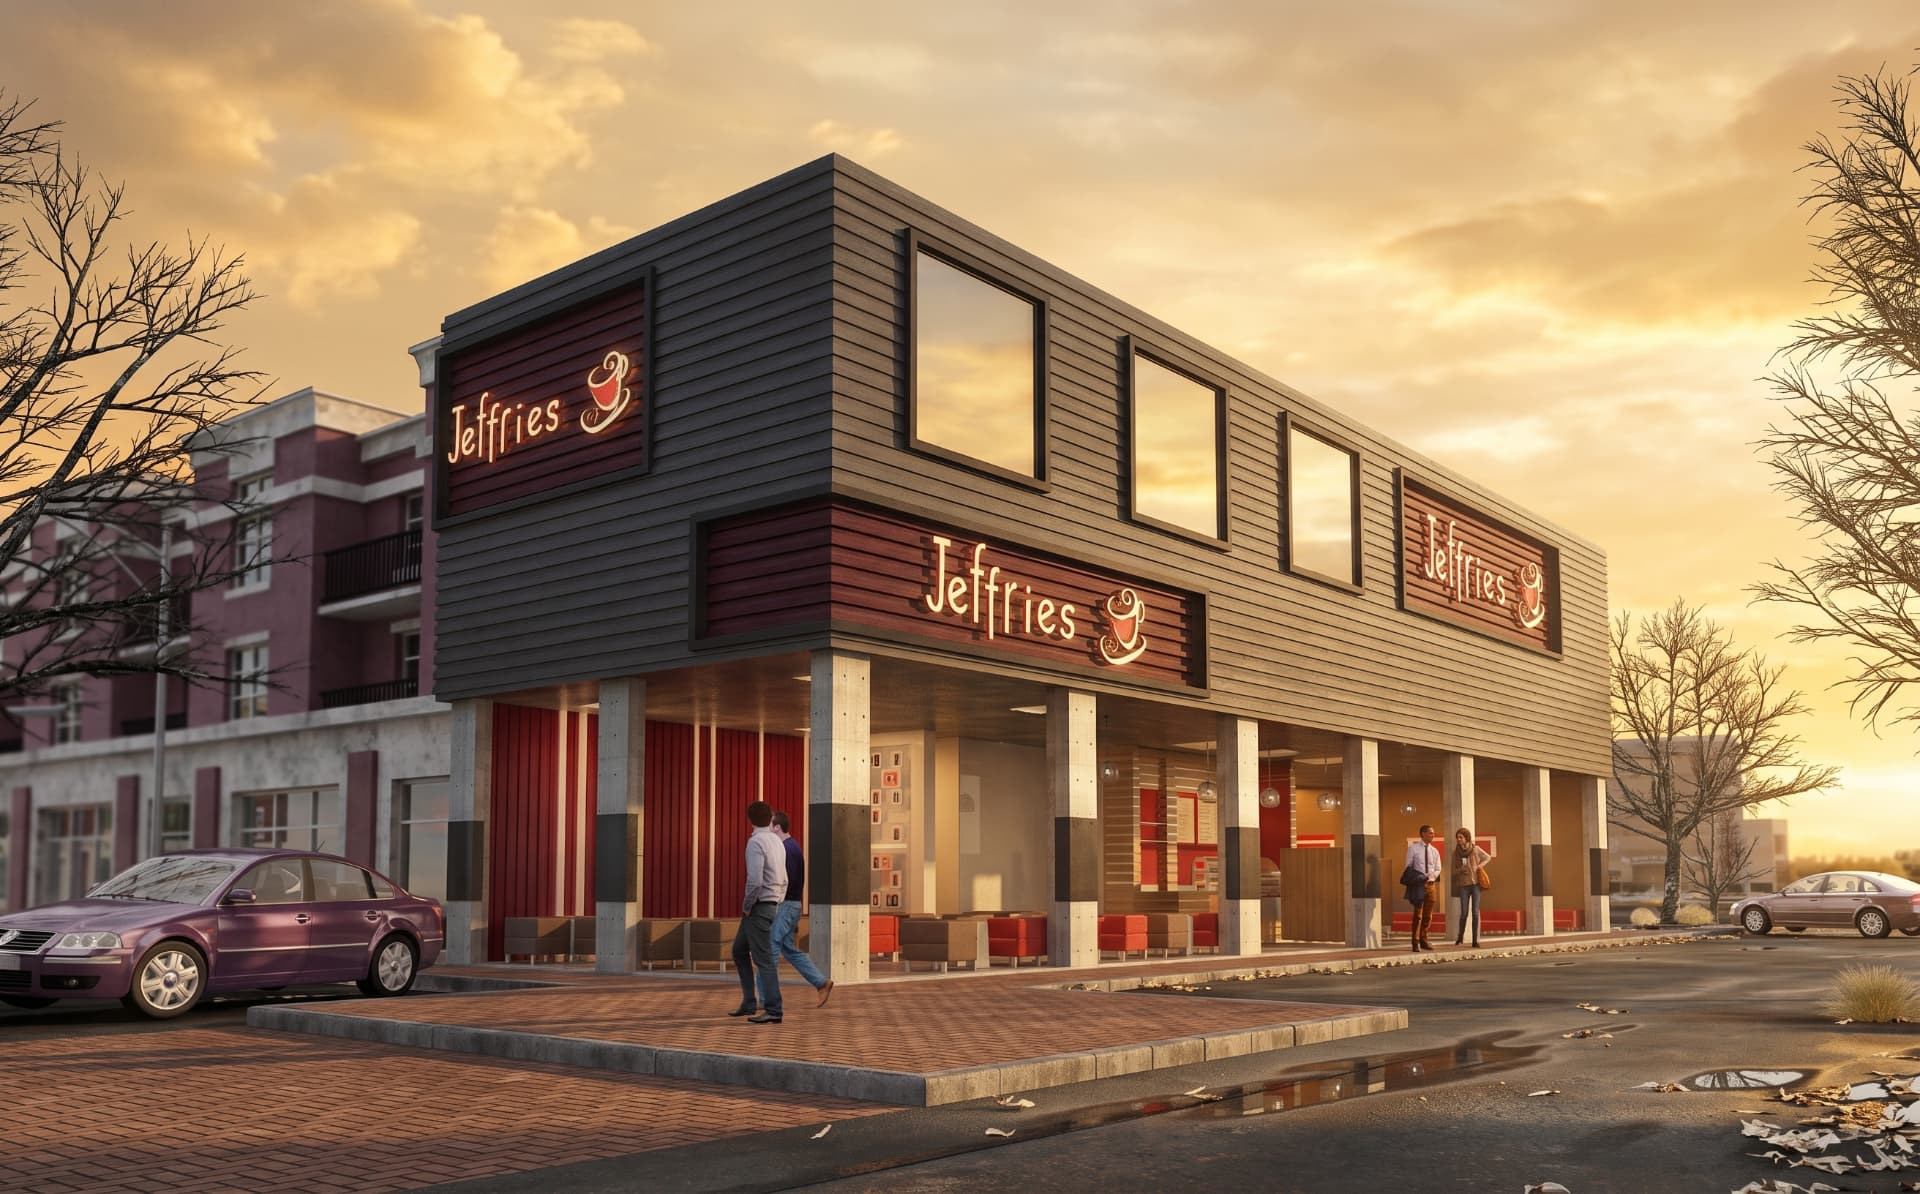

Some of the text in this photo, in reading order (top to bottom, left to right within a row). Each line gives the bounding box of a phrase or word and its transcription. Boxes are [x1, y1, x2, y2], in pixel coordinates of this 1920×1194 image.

[448, 392, 560, 464] Jeffries
[926, 535, 1076, 640] Jeffries
[1425, 514, 1506, 605] Jeffries
